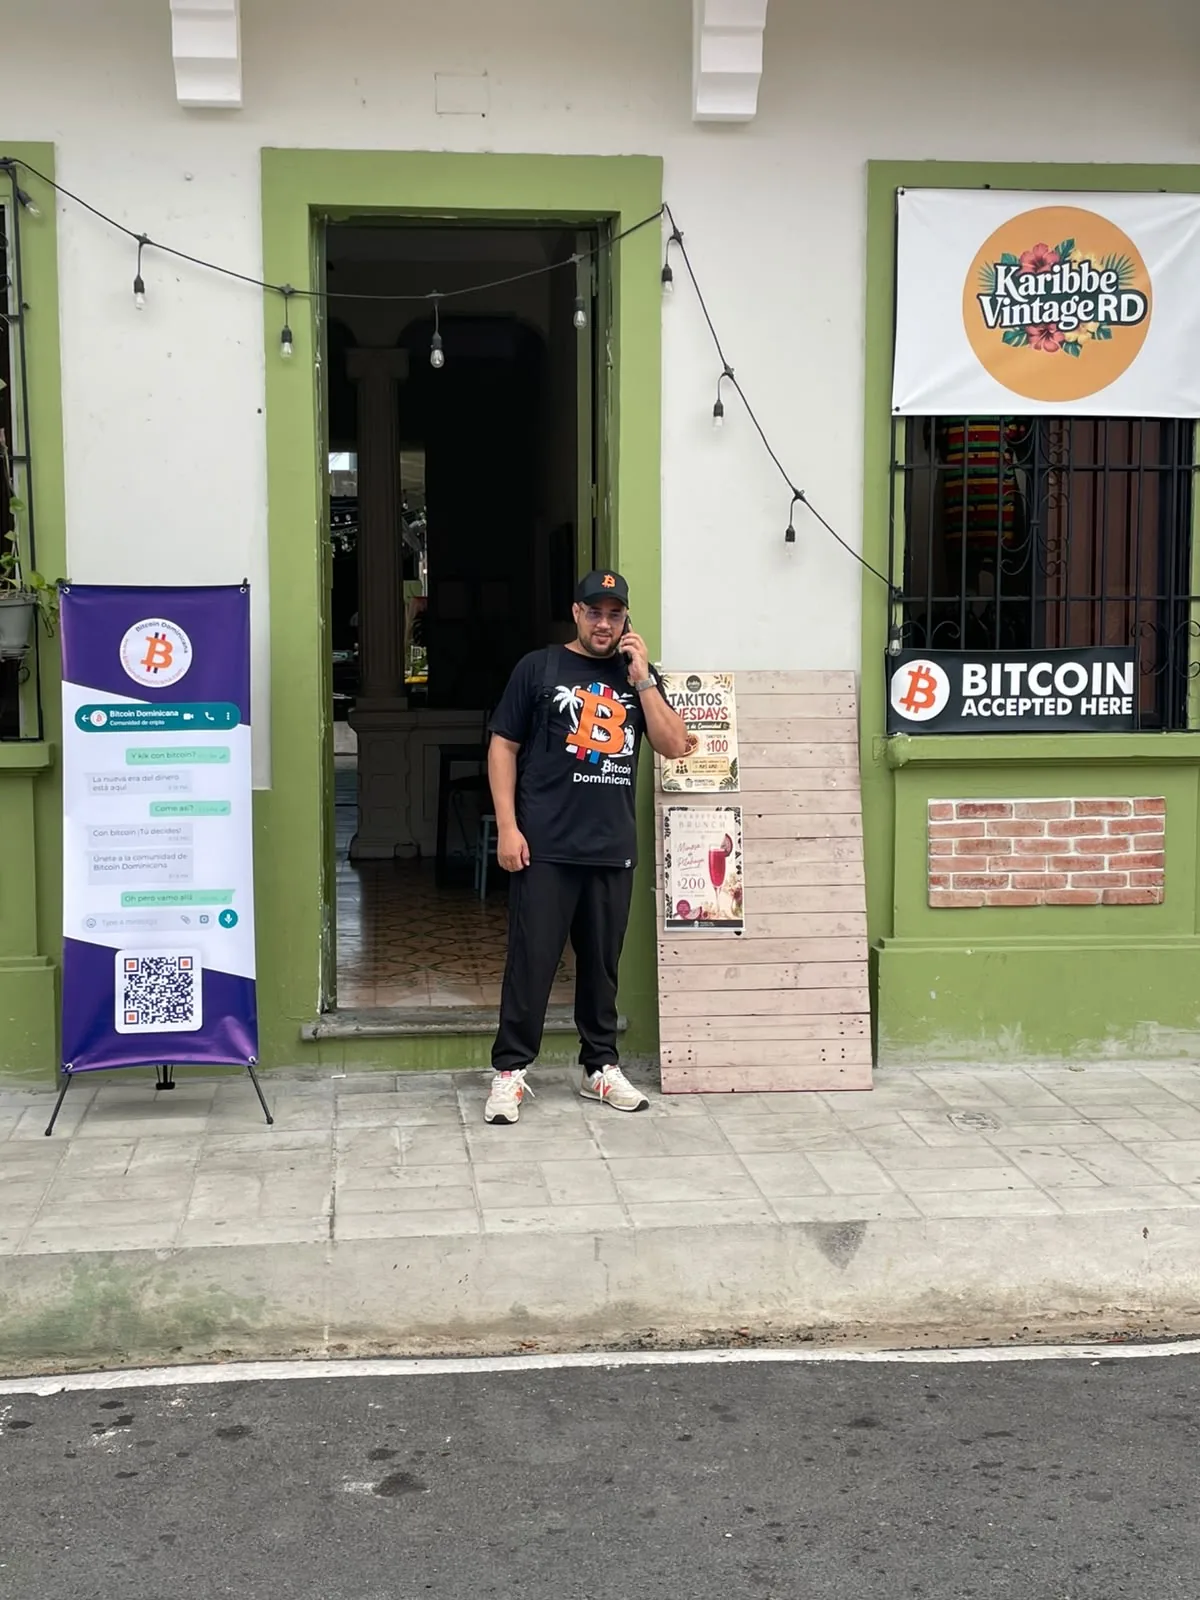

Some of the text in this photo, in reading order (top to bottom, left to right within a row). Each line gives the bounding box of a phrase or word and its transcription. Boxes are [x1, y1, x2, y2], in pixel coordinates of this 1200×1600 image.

[995, 261, 1117, 302] Karibbe
[135, 621, 188, 653] Bitcoin Dominicana
[961, 661, 1134, 697] BITCOIN
[668, 693, 723, 706] TAKITOS
[961, 697, 1133, 717] ACCEPTED HERE
[109, 708, 179, 719] Bitcoin Dominicana
[149, 719, 165, 727] cripto
[706, 739, 729, 753] $100
[166, 751, 196, 759] bitcoin?
[141, 774, 154, 782] del
[154, 774, 180, 782] dinero
[679, 821, 726, 829] BRUNCH
[92, 829, 108, 837] Con
[110, 828, 136, 837] bitcoin
[124, 854, 131, 862] la
[132, 853, 176, 862] comunidad
[93, 862, 168, 871] Bitcoin Dominicana
[677, 877, 706, 890] $200
[138, 895, 156, 903] pero
